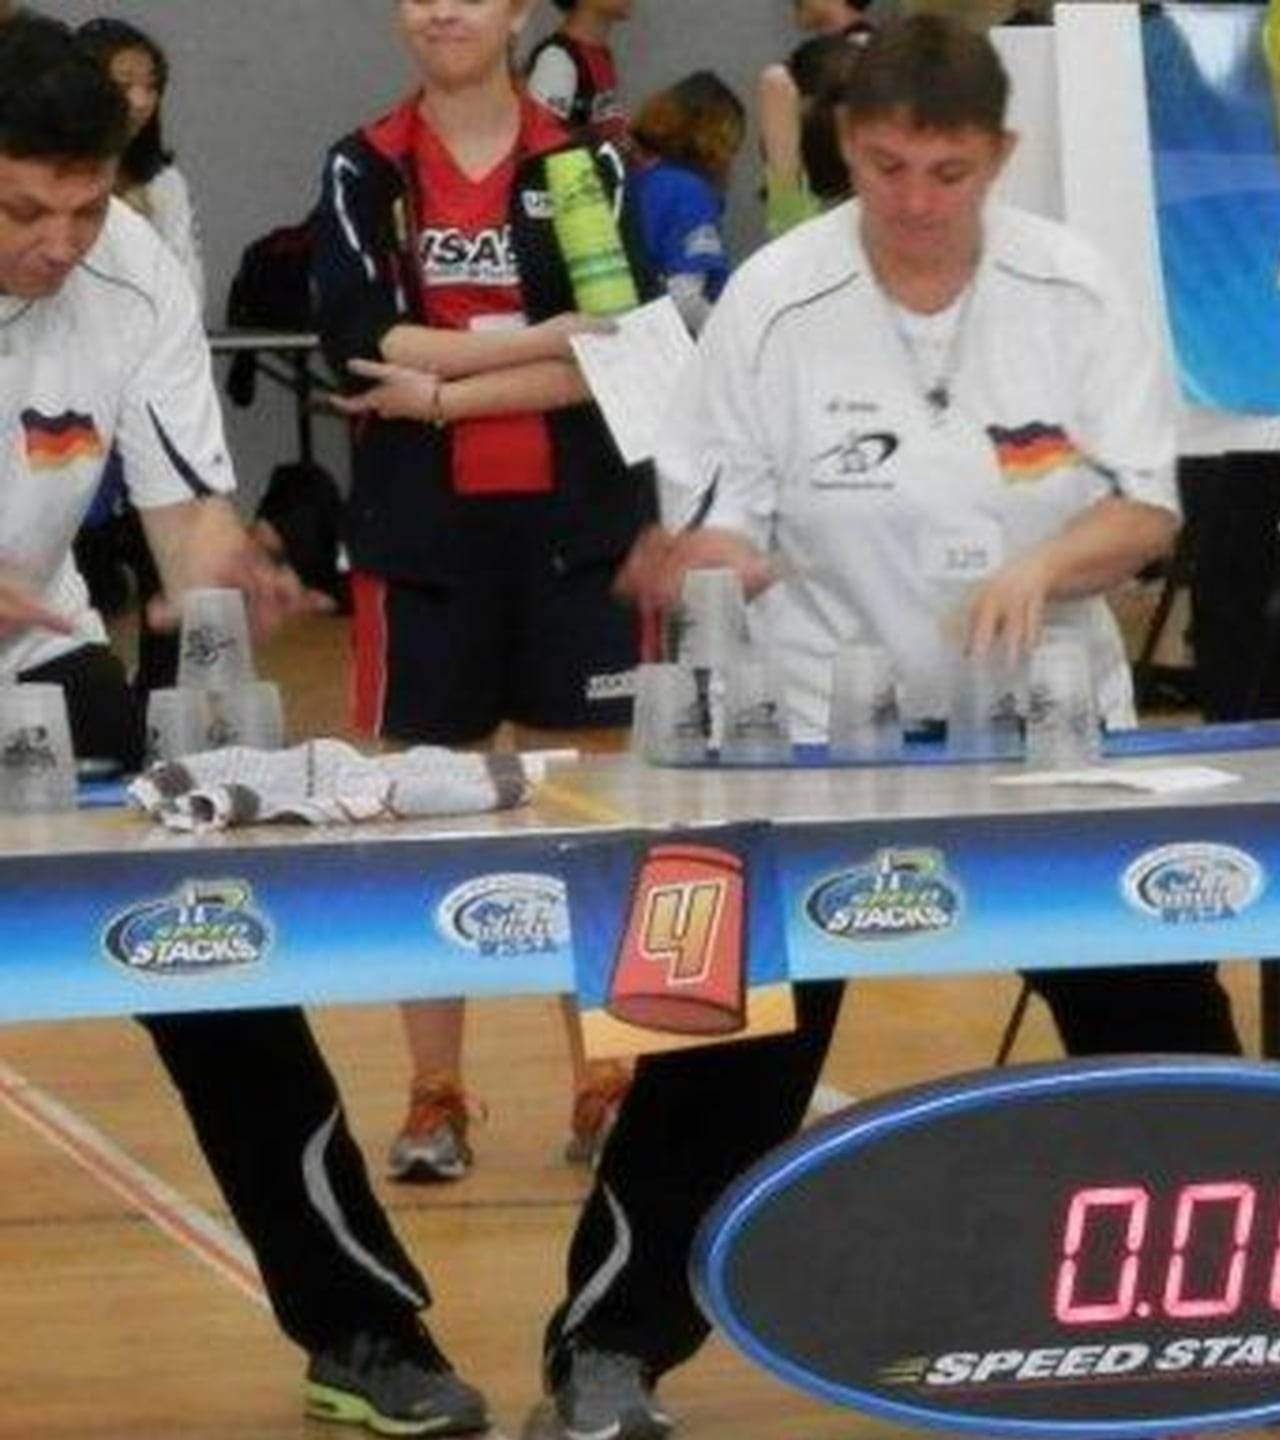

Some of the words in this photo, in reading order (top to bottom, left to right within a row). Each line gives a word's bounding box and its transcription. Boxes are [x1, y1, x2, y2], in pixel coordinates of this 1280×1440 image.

[642, 877, 728, 987] 4
[825, 905, 950, 931] STACKS
[129, 939, 258, 965] STACKS
[925, 1341, 1151, 1386] SPEED
